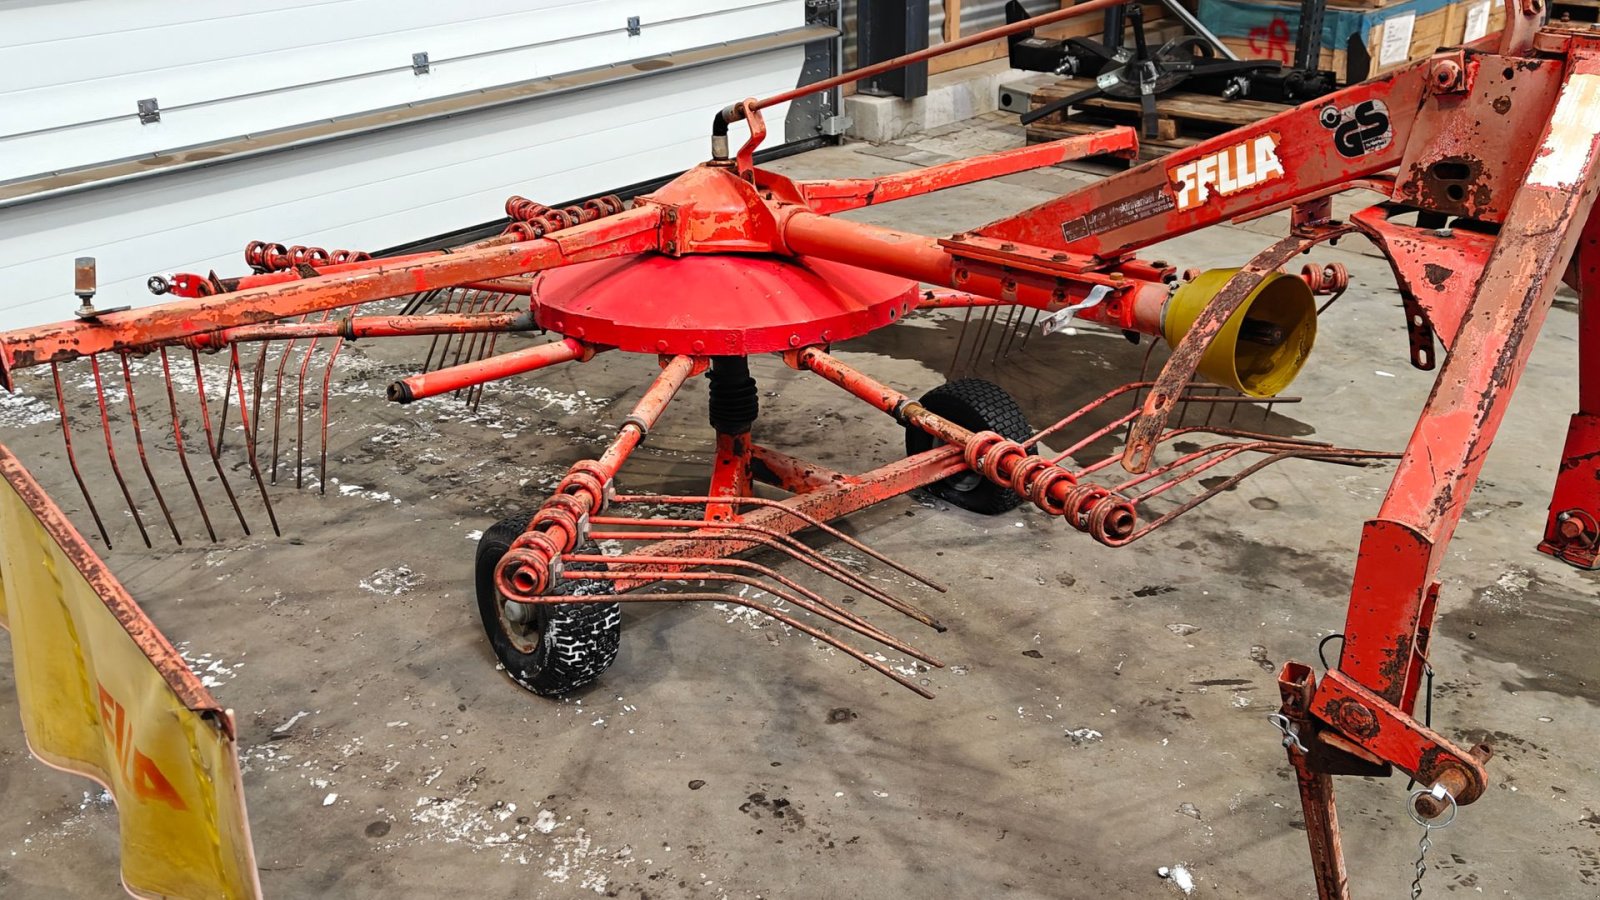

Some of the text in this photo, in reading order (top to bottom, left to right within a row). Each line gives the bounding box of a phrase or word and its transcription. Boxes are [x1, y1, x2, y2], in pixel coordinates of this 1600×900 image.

[1334, 101, 1389, 157] GS
[1176, 135, 1285, 209] FELLA
[97, 680, 191, 812] ELLA
